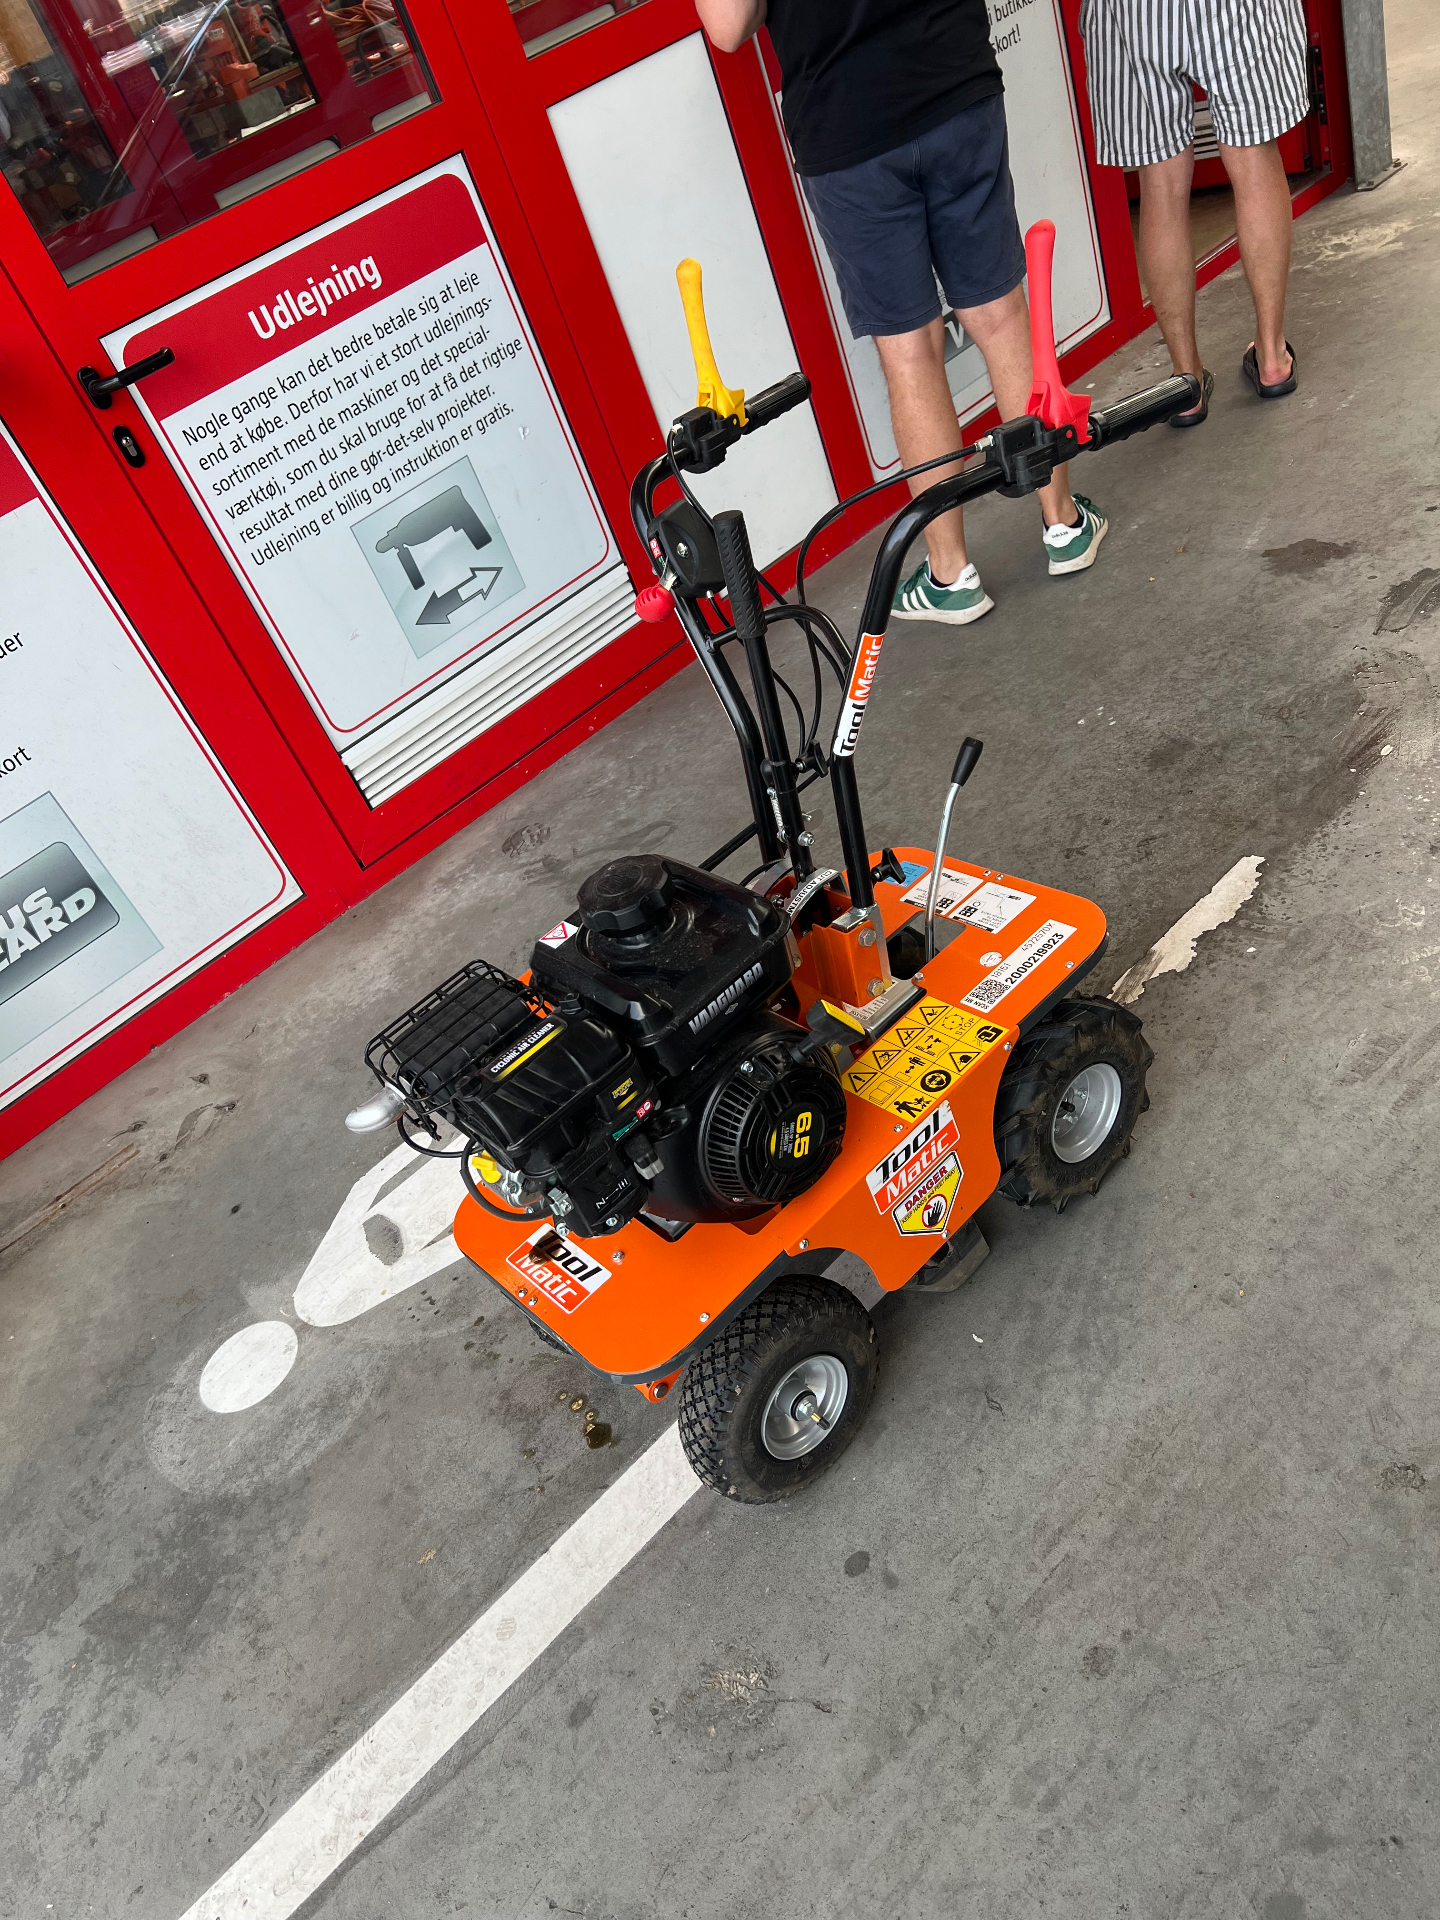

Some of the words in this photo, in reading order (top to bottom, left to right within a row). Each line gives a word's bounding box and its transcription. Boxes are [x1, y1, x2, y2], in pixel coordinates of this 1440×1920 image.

[987, 7, 993, 25] i
[248, 255, 383, 340] Udlejning
[181, 412, 231, 447] Nogle
[231, 386, 279, 424] gange
[276, 370, 307, 394] kan
[307, 352, 334, 378] det
[330, 332, 374, 364] bedre
[371, 307, 418, 341] betale
[418, 295, 440, 316] sig
[439, 283, 456, 304] at
[453, 271, 480, 295] leje
[198, 441, 229, 471] end
[229, 433, 248, 454] at
[244, 415, 289, 444] købe.
[287, 385, 334, 421] Derfor
[332, 371, 359, 395] har
[359, 359, 375, 379] vi
[375, 351, 392, 371] et
[391, 333, 424, 363] stort
[423, 297, 493, 344] udlejnings-
[212, 445, 284, 497] sortiment
[283, 423, 318, 456] med
[318, 416, 338, 436] de
[337, 379, 399, 424] maskiner
[400, 368, 421, 387] og
[420, 352, 444, 376] det
[443, 324, 491, 363] special-
[224, 476, 287, 520] værktøj,
[286, 459, 318, 486] som
[318, 446, 339, 466] du
[338, 426, 367, 455] skal
[364, 407, 408, 438] bruge
[406, 393, 427, 414] for
[428, 382, 444, 402] at
[442, 372, 459, 393] få
[459, 360, 482, 383] det
[481, 338, 523, 370] rigtige
[239, 501, 295, 544] resultat
[294, 479, 328, 511] med
[328, 465, 360, 491] dine
[360, 418, 435, 476] gør-det-selv
[436, 384, 496, 430] projekter.
[250, 519, 321, 566] Udlejning
[320, 508, 336, 526] er
[334, 488, 372, 516] billig
[372, 476, 392, 495] og
[389, 434, 460, 484] instruktion
[460, 424, 474, 441] er
[475, 402, 514, 435] gratis.
[840, 703, 867, 754] Tool
[855, 638, 884, 698] Matic
[1004, 932, 1065, 985] 2000219923
[688, 962, 764, 1035] VANGUARD
[955, 1017, 976, 1037] STOP
[490, 1046, 521, 1073] CYCLONIC
[519, 1040, 531, 1055] AIR
[527, 1022, 555, 1044] CLEANER
[793, 1111, 812, 1159] 6.5
[876, 1109, 940, 1184] Tool
[886, 1132, 950, 1204] Matic
[904, 1165, 949, 1212] DANGER
[515, 1253, 578, 1304] Matic
[534, 1230, 603, 1282] Tool
